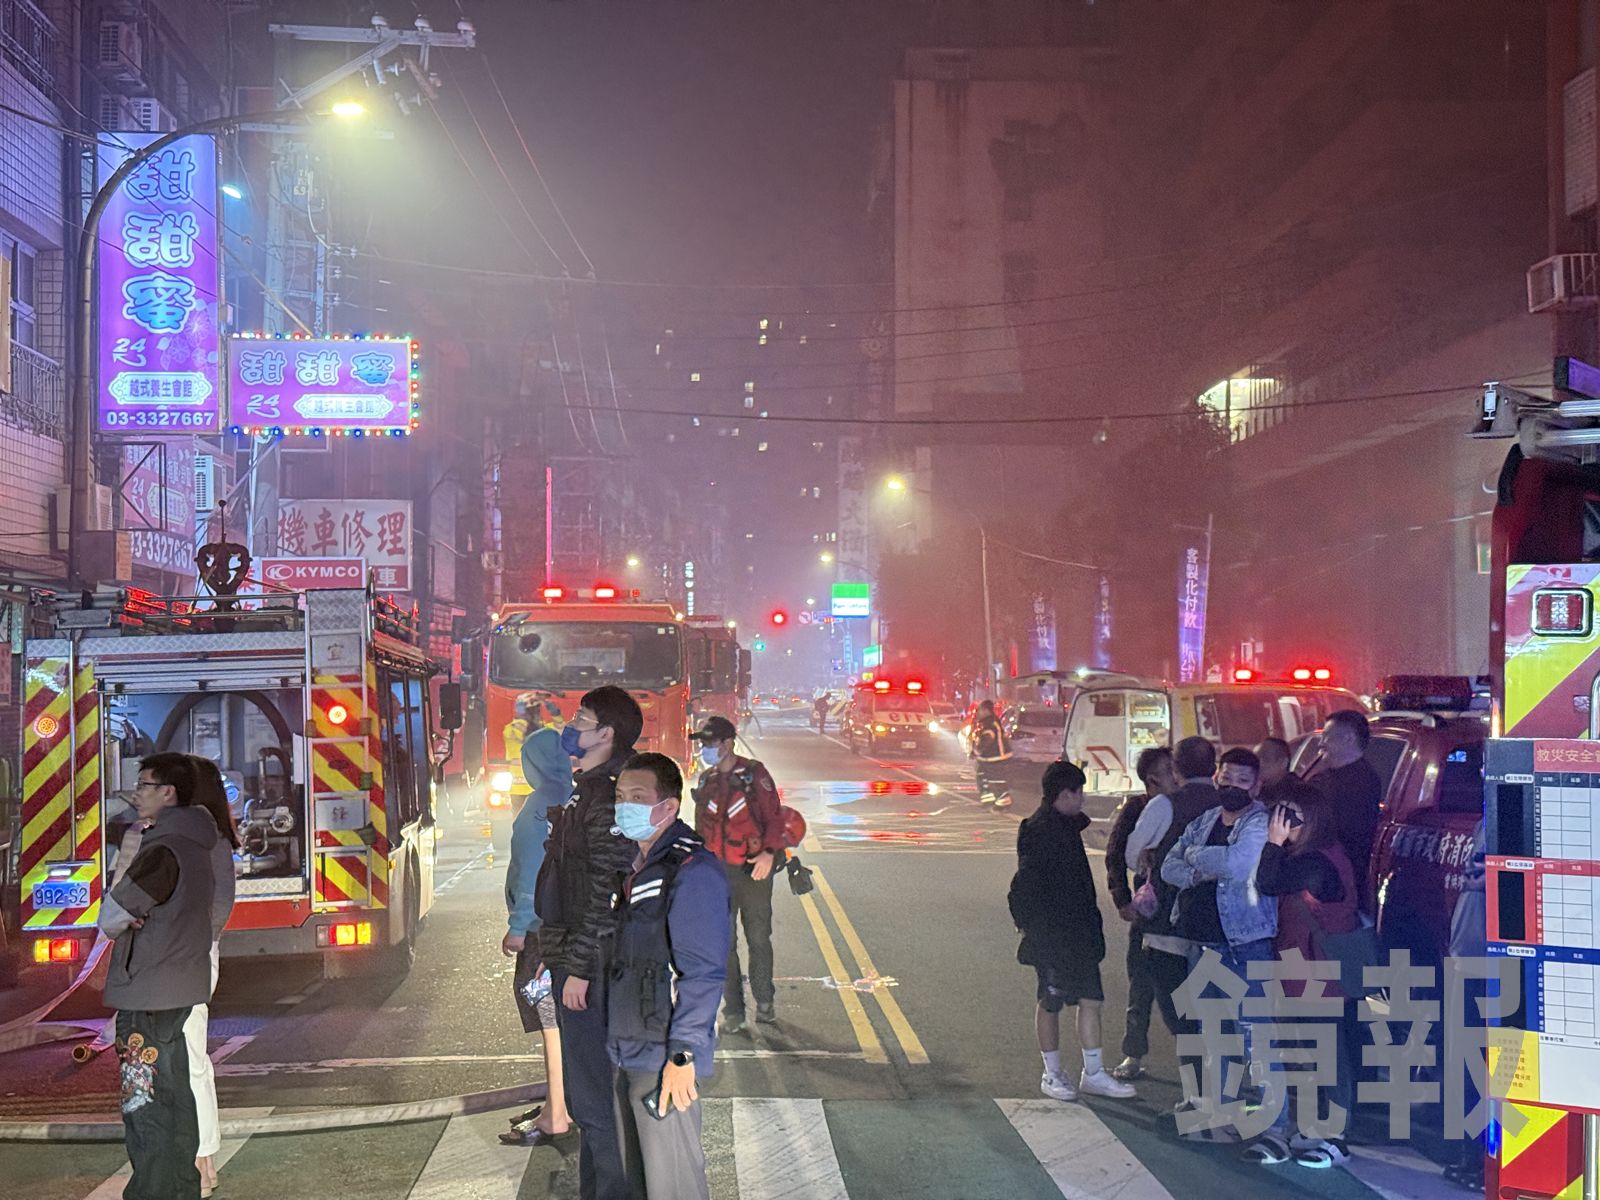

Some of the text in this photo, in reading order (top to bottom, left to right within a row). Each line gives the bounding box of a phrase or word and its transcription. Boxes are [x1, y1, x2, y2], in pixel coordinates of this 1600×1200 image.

[123, 148, 198, 333] 甜甜蜜
[113, 338, 147, 353] 24
[240, 350, 394, 386] 甜甜蜜
[130, 379, 193, 398] 越式養生會館
[249, 394, 280, 407] 24
[107, 411, 215, 426] 03-3327667
[278, 507, 406, 557] 機車修理
[295, 566, 360, 579] KYMCO
[1184, 547, 1199, 628] 客製化付款
[35, 887, 88, 906] 992-S2
